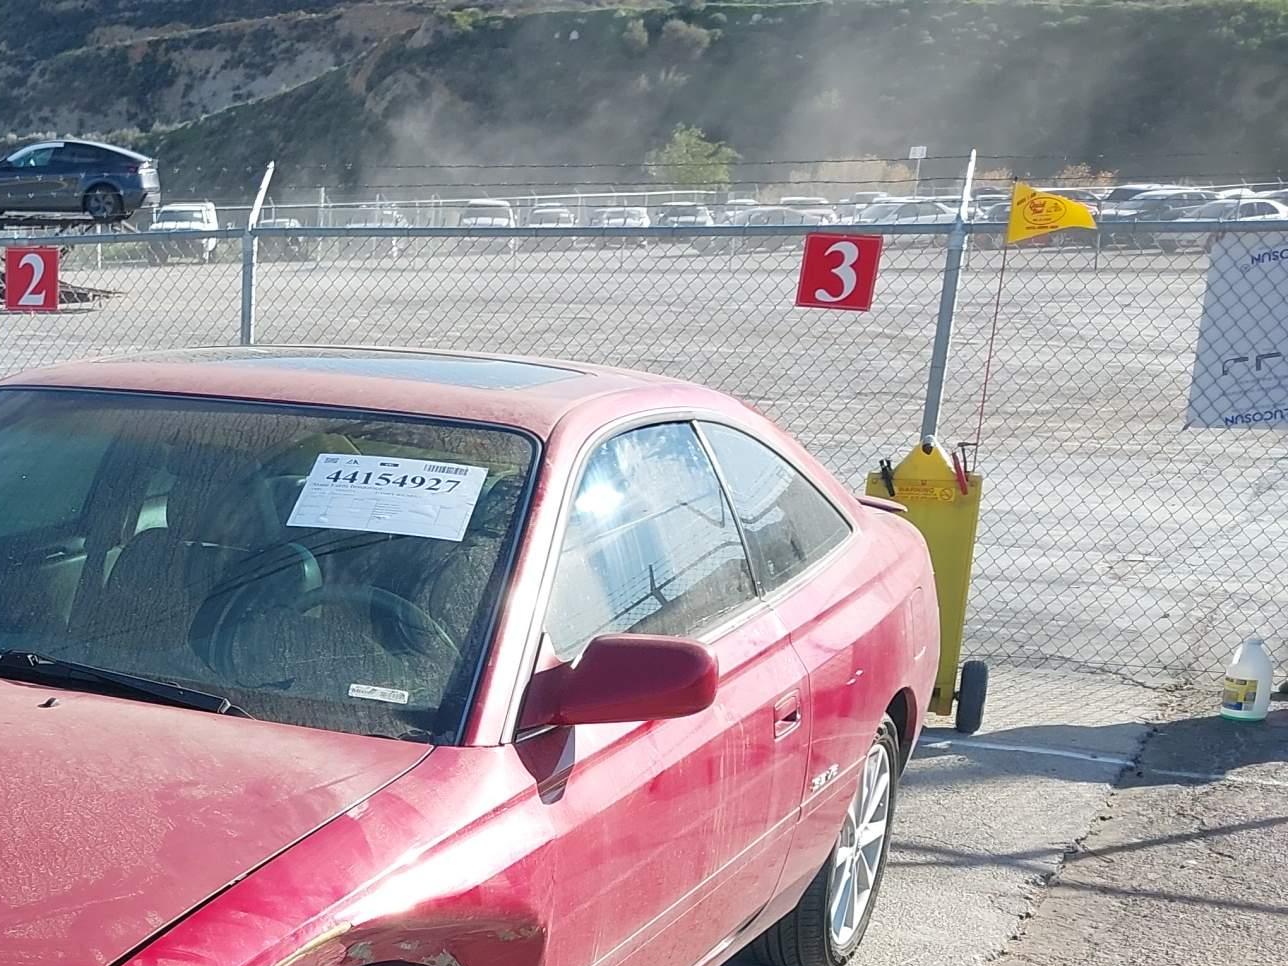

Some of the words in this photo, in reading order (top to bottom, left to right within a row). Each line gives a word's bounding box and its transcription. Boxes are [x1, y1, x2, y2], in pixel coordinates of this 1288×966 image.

[18, 253, 46, 306] 2
[814, 240, 860, 303] 3
[326, 469, 462, 494] 44154927
